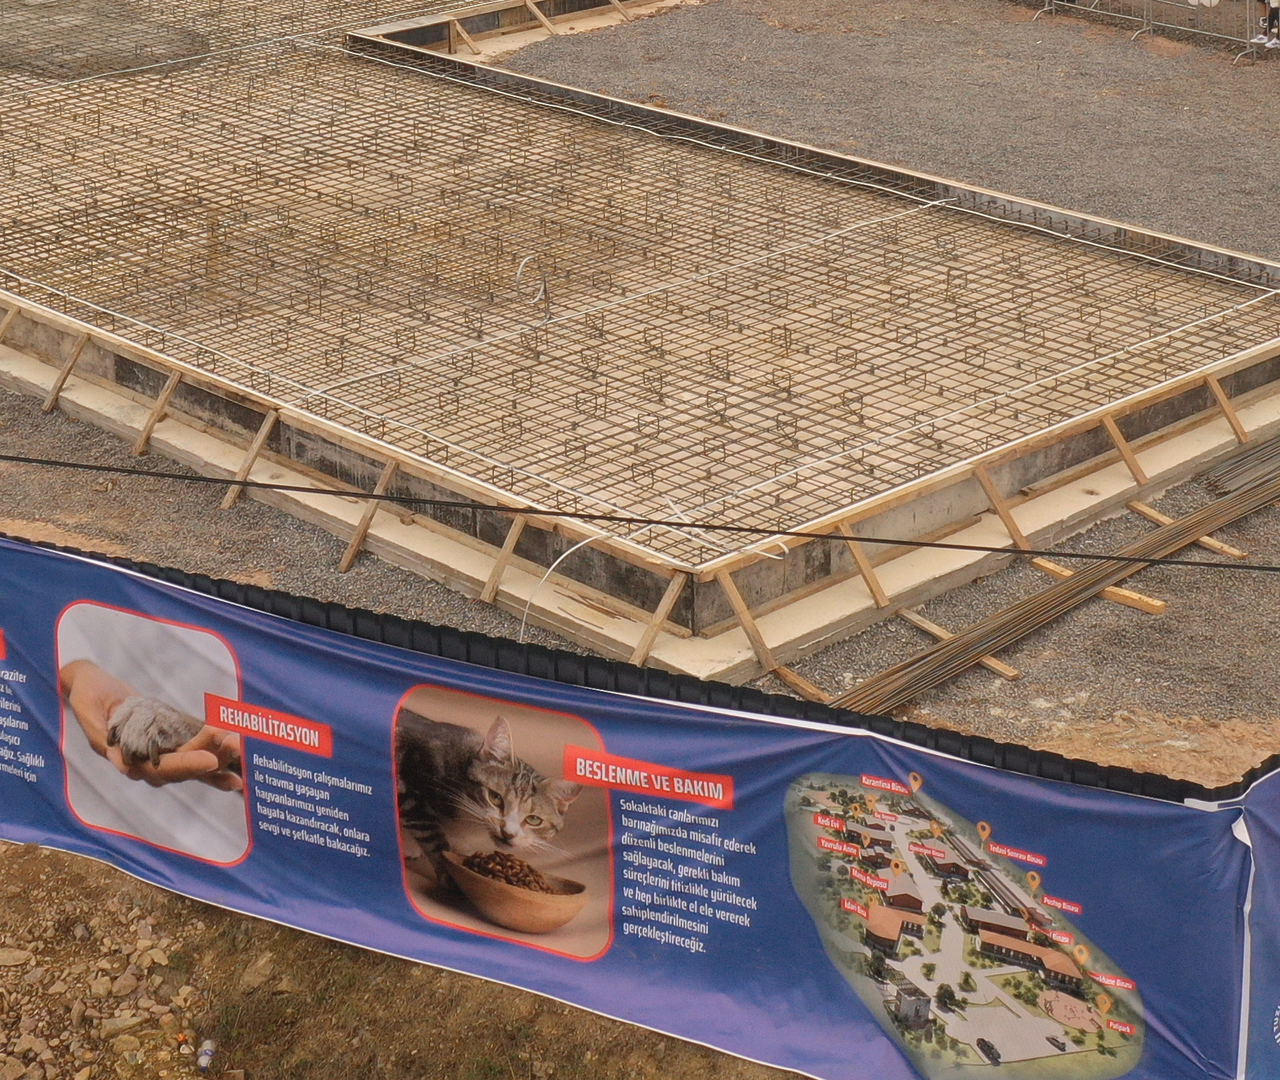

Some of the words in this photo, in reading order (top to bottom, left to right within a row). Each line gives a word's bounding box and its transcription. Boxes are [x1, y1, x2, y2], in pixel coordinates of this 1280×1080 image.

[220, 705, 319, 747] REHABİLİTASYON
[17, 752, 45, 768] Sağlıklı
[253, 754, 312, 780] Rehabilitasyon
[314, 772, 372, 795] çalışmalarımız
[254, 771, 264, 783] ile
[266, 774, 294, 791] travma
[295, 785, 330, 801] yaşayan
[576, 757, 649, 788] BESLENME
[651, 774, 670, 791] VE
[674, 777, 723, 800] BAKIM
[862, 776, 890, 789] Karantina
[255, 786, 315, 811] hayvanlarımızı
[316, 804, 349, 821] yeniden
[620, 799, 667, 817] Sokaktaki
[669, 809, 719, 828] canlarımızı
[257, 803, 285, 820] hayata
[286, 811, 342, 837] kazandıracak,
[343, 827, 370, 842] onlara
[622, 815, 688, 839] barınağımızda
[690, 830, 722, 848] misafir
[724, 839, 757, 855] ederek
[818, 816, 830, 826] Kedi
[830, 818, 840, 828] Evi
[259, 821, 280, 836] sevgi
[281, 828, 291, 837] ve
[292, 829, 325, 846] şefkatle
[326, 837, 371, 858] bakacağız.
[622, 833, 656, 850] düzenli
[658, 839, 725, 866] beslenmelerini
[989, 844, 1007, 855] Tedavi
[623, 850, 676, 874] sağlayacak,
[677, 864, 709, 880] gerekli
[711, 871, 741, 888] bakım
[623, 868, 669, 889] süreçlerini
[671, 880, 709, 898] titizlikle
[710, 887, 758, 911] yürütecek
[1043, 896, 1062, 909] Postop
[622, 905, 709, 934] sahiplendirilmesini
[623, 886, 634, 898] ve
[635, 887, 652, 904] hep
[653, 892, 687, 910] birlikte
[689, 901, 698, 913] el
[699, 903, 713, 917] ele
[715, 908, 751, 928] vererek
[623, 922, 707, 953] gerçekleştireceğiz.
